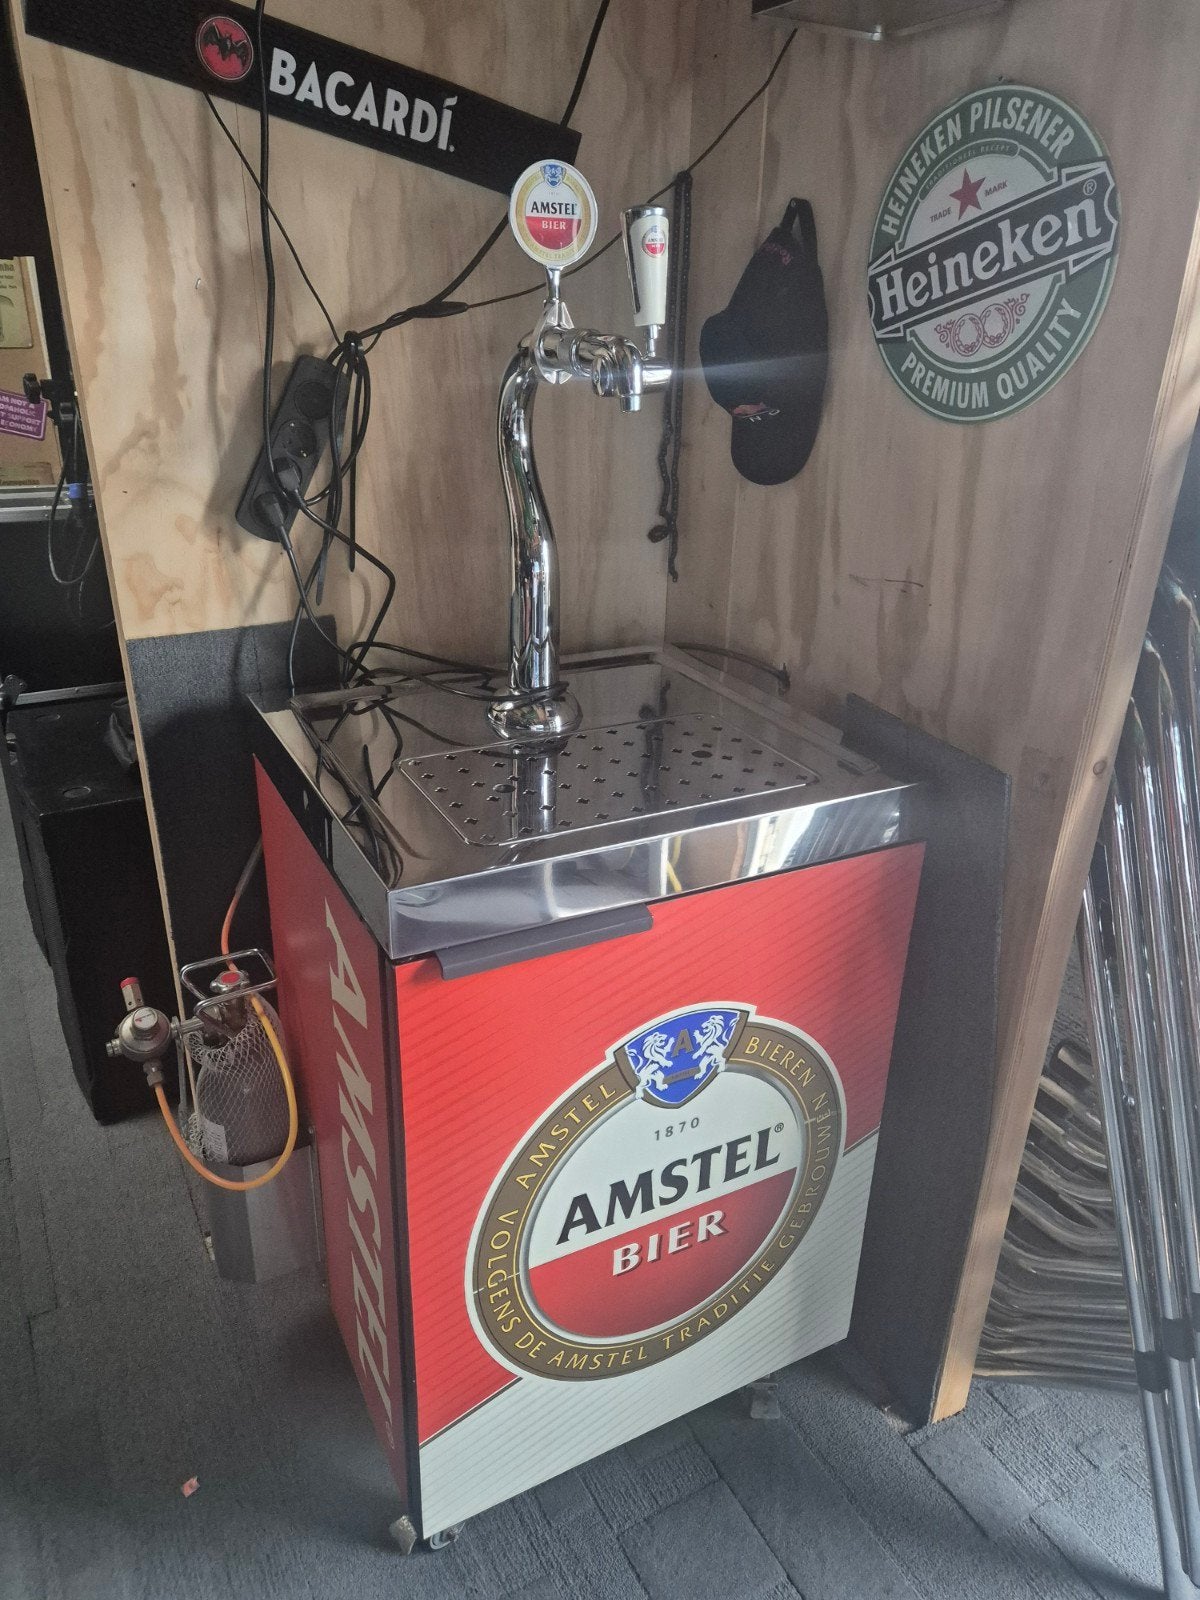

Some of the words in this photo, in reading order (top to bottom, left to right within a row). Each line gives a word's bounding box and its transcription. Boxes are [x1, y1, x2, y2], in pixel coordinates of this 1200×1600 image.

[881, 112, 962, 236] HEINEKEN
[969, 97, 1075, 159] PILSENER
[929, 206, 952, 223] TRADE
[984, 180, 1008, 197] MARK
[541, 220, 567, 230] BIER
[876, 199, 1102, 321] Heineken
[900, 351, 990, 409] PREMIUM
[996, 298, 1082, 400] QUALITY
[324, 896, 393, 1426] AMSTEL
[515, 1084, 616, 1191] AMSTEL
[746, 1036, 817, 1088] BIEREN
[654, 1116, 701, 1141] 1870
[487, 1209, 522, 1333] VOLGENS
[514, 1331, 547, 1358] DE
[547, 1346, 648, 1371] AMSTEL
[662, 1260, 775, 1350] TRADITIE
[778, 1091, 832, 1249] GEBROUWEN
[612, 1210, 727, 1277] BIER
